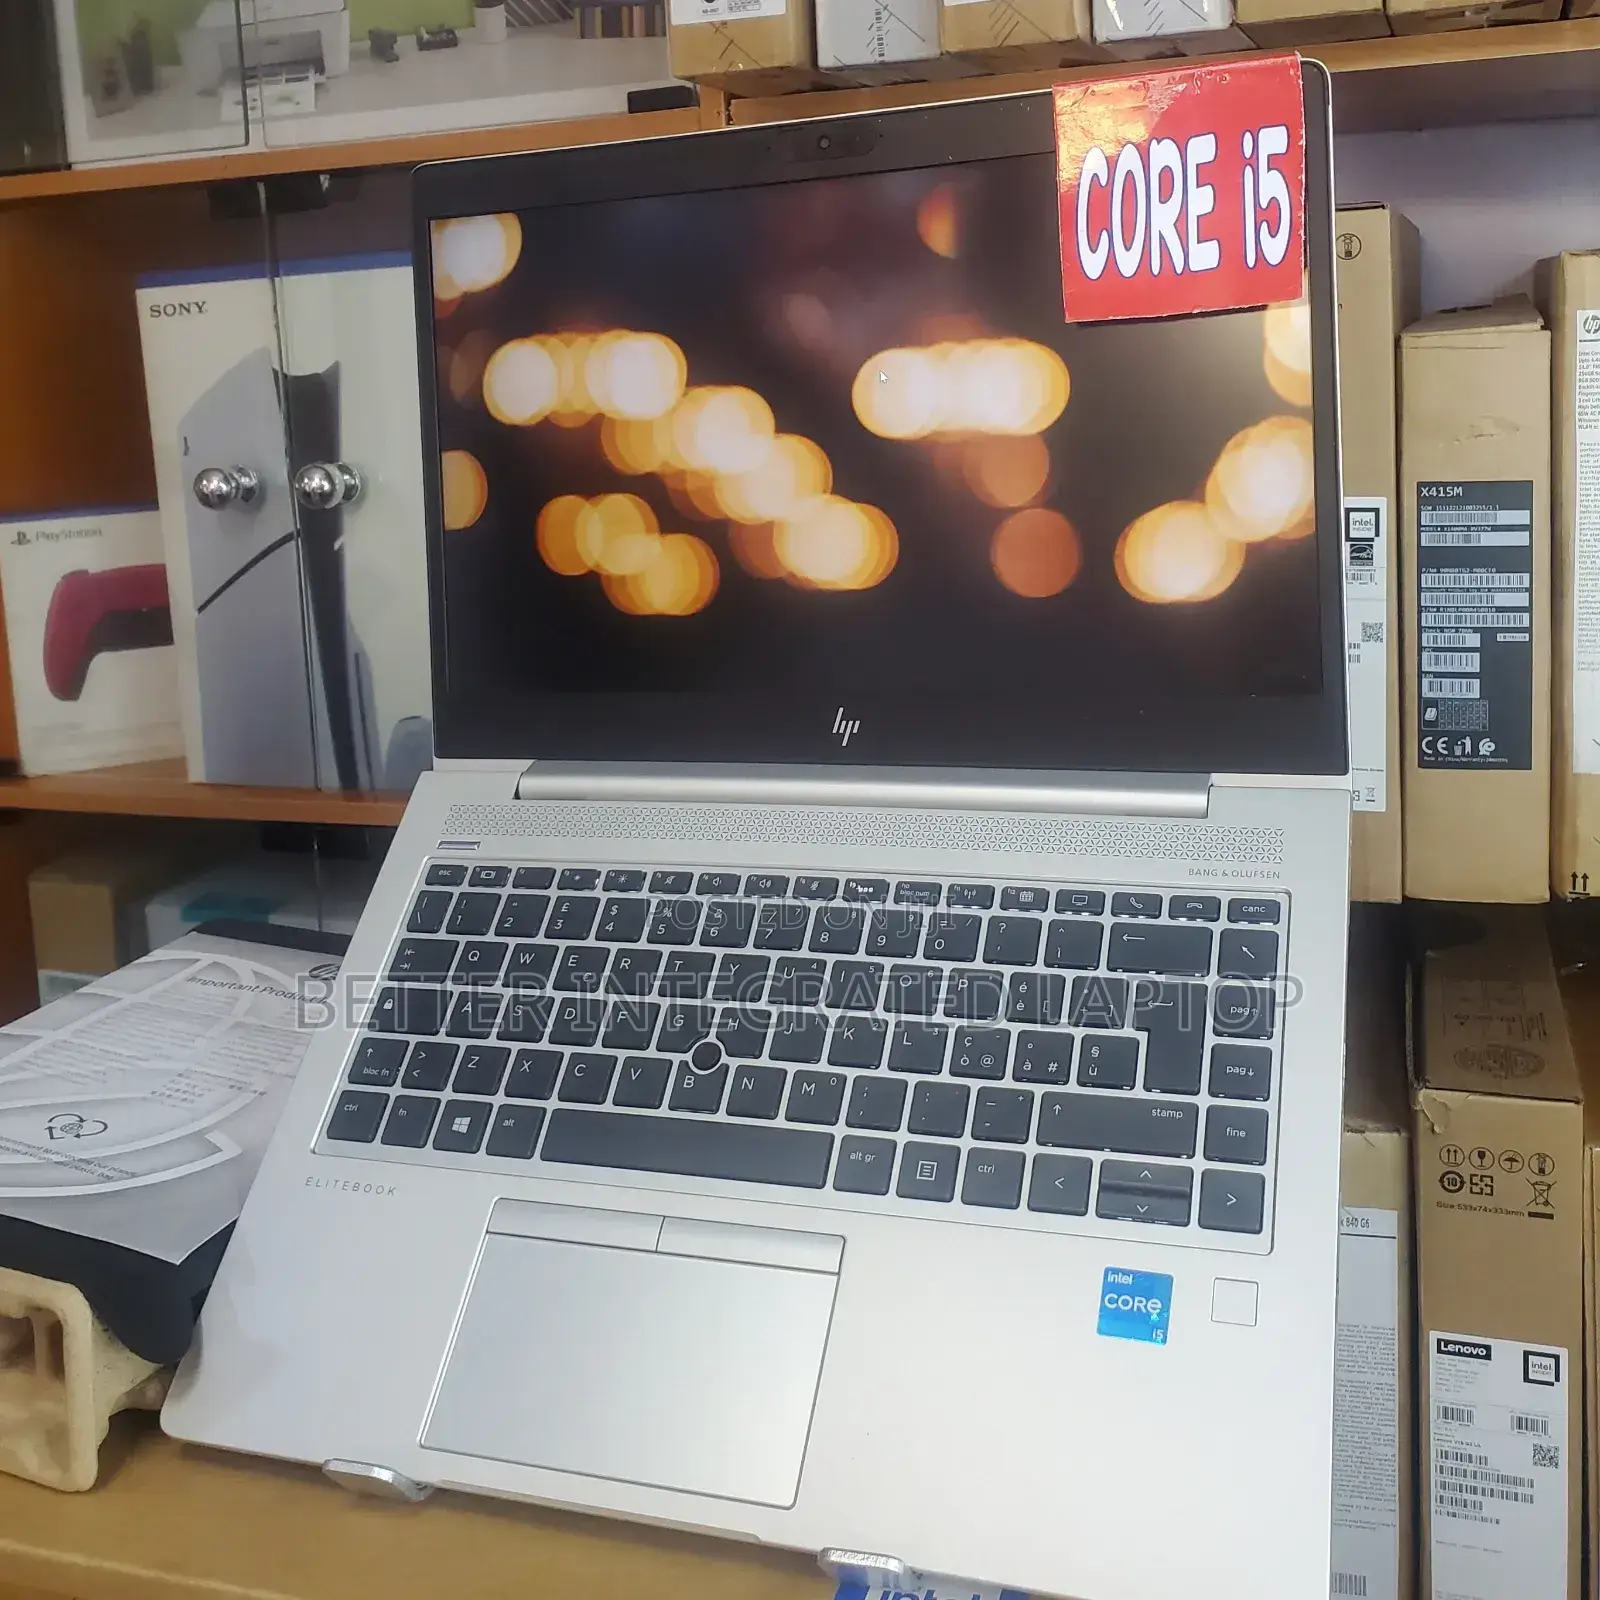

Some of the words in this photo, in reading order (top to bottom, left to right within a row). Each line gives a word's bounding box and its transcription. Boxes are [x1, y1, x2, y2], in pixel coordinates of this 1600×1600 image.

[1076, 132, 1220, 281] CORE
[1242, 124, 1292, 270] i5
[149, 301, 207, 318] SONY
[1420, 486, 1463, 498] X415M
[36, 528, 103, 542] PlayStation
[832, 707, 860, 747] hp
[1188, 868, 1218, 877] BANG
[1221, 869, 1228, 877] &
[1231, 869, 1280, 879] OLUFSEN
[1242, 905, 1266, 913] canc
[456, 916, 462, 925] 1
[504, 917, 514, 927] 2
[554, 919, 564, 930] 3
[605, 921, 614, 932] 4
[657, 924, 665, 934] 5
[710, 927, 719, 937] 6
[765, 929, 773, 939] 7
[819, 932, 828, 943] 8
[877, 935, 886, 947] 9
[935, 938, 944, 949] 0
[468, 950, 480, 962] Q
[520, 952, 535, 964] W
[568, 955, 578, 967] E
[620, 958, 631, 970] R
[674, 961, 683, 972] T
[729, 963, 740, 976] Y
[784, 967, 796, 979] U
[840, 970, 845, 982] I
[186, 975, 260, 993] Important
[899, 974, 912, 987] O
[958, 979, 968, 992] P
[461, 1001, 472, 1014] A
[513, 1005, 523, 1017] S
[1230, 1005, 1249, 1015] pag
[564, 1008, 576, 1020] D
[617, 1011, 628, 1023] F
[674, 1014, 684, 1027] G
[728, 1018, 739, 1030] H
[784, 1022, 793, 1035] J
[843, 1027, 855, 1040] K
[903, 1032, 912, 1045] L
[468, 1056, 479, 1068] Z
[520, 1060, 532, 1072] X
[363, 1066, 378, 1075] bloc
[380, 1068, 390, 1077] fn
[574, 1064, 586, 1077] C
[630, 1068, 642, 1081] V
[1226, 1065, 1246, 1076] pag
[684, 1075, 694, 1088] B
[742, 1078, 754, 1090] N
[802, 1082, 815, 1096] M
[344, 1103, 358, 1112] ctrl
[398, 1108, 407, 1116] fn
[1151, 1107, 1183, 1119] stamp
[503, 1118, 515, 1127] alt
[1226, 1127, 1246, 1137] fine
[850, 1151, 862, 1161] alt
[864, 1152, 876, 1162] gr
[978, 1163, 995, 1174] ctrl
[305, 1176, 397, 1196] ELITEBOOK
[1107, 1271, 1133, 1285] intel
[1152, 1327, 1164, 1341] i5
[1440, 1340, 1487, 1356] Lenovo
